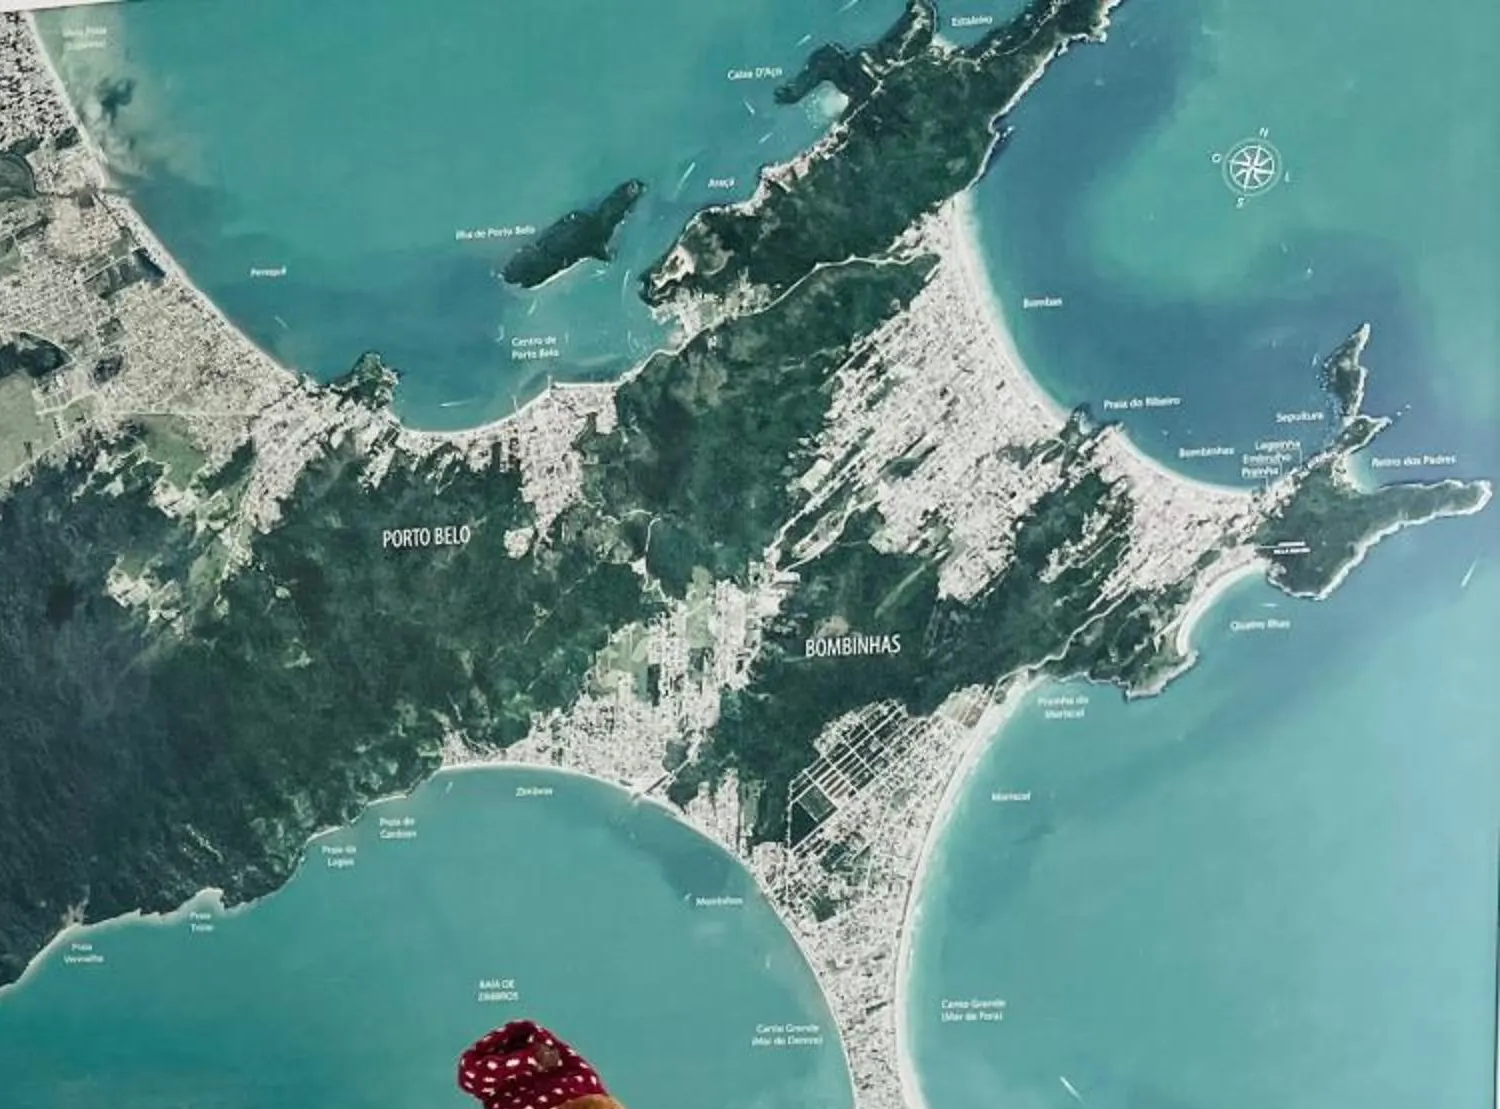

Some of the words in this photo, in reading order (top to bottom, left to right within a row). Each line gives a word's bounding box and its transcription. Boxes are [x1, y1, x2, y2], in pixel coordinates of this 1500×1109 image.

[383, 528, 430, 548] PORTO
[434, 525, 471, 545] BELO
[804, 633, 902, 658] BOMBINHAS
